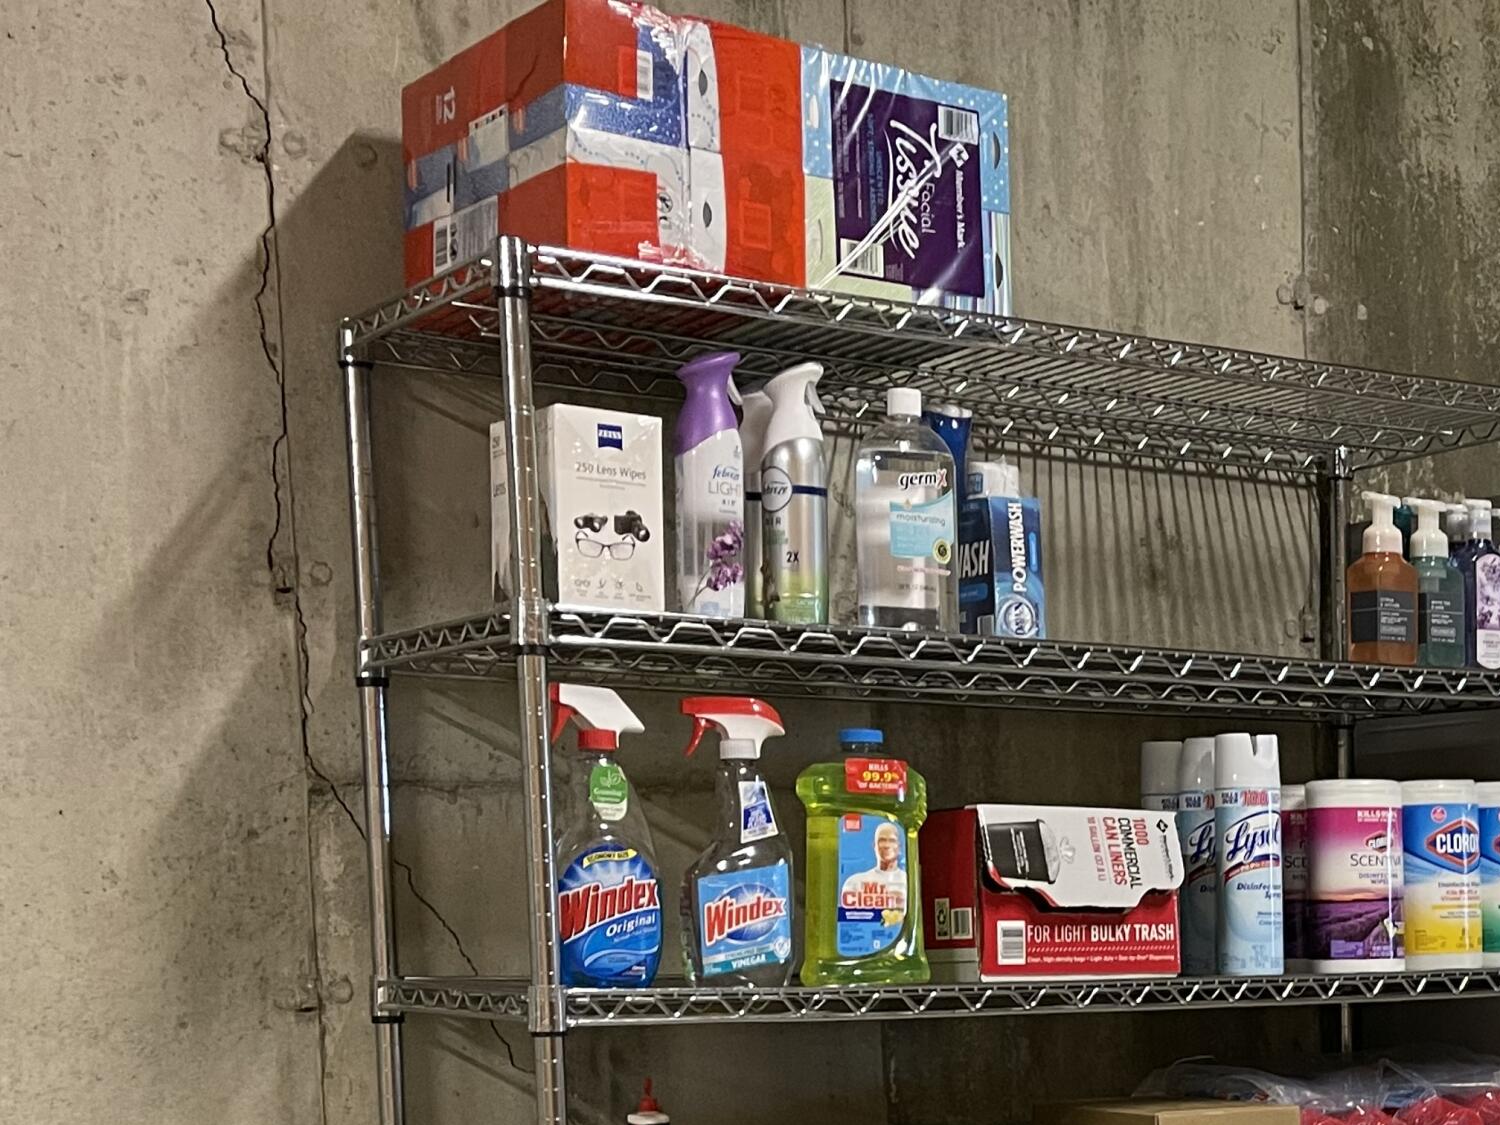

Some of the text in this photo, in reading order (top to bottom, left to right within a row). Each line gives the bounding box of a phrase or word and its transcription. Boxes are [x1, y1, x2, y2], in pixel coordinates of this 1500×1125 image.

[921, 182, 936, 233] Facial
[598, 430, 622, 440] ZEISS
[576, 462, 647, 481] 250 Lens Wipes
[900, 469, 947, 489] germX
[896, 512, 946, 527] moisturizing
[787, 551, 800, 563] 2X
[1008, 502, 1028, 592] POWERWASH
[868, 763, 888, 771] KILLS
[1132, 817, 1149, 846] 1000
[1102, 816, 1128, 886] CAN LINERS
[1117, 817, 1143, 889] COMMERCIAL
[1436, 833, 1480, 854] CLORO
[863, 881, 888, 895] Mr.
[559, 878, 658, 941] Windex
[606, 915, 656, 938] Original
[706, 898, 784, 944] Windex
[1027, 923, 1175, 943] FOR LIGHT BULKY TRASH
[731, 954, 766, 969] VINEGAR
